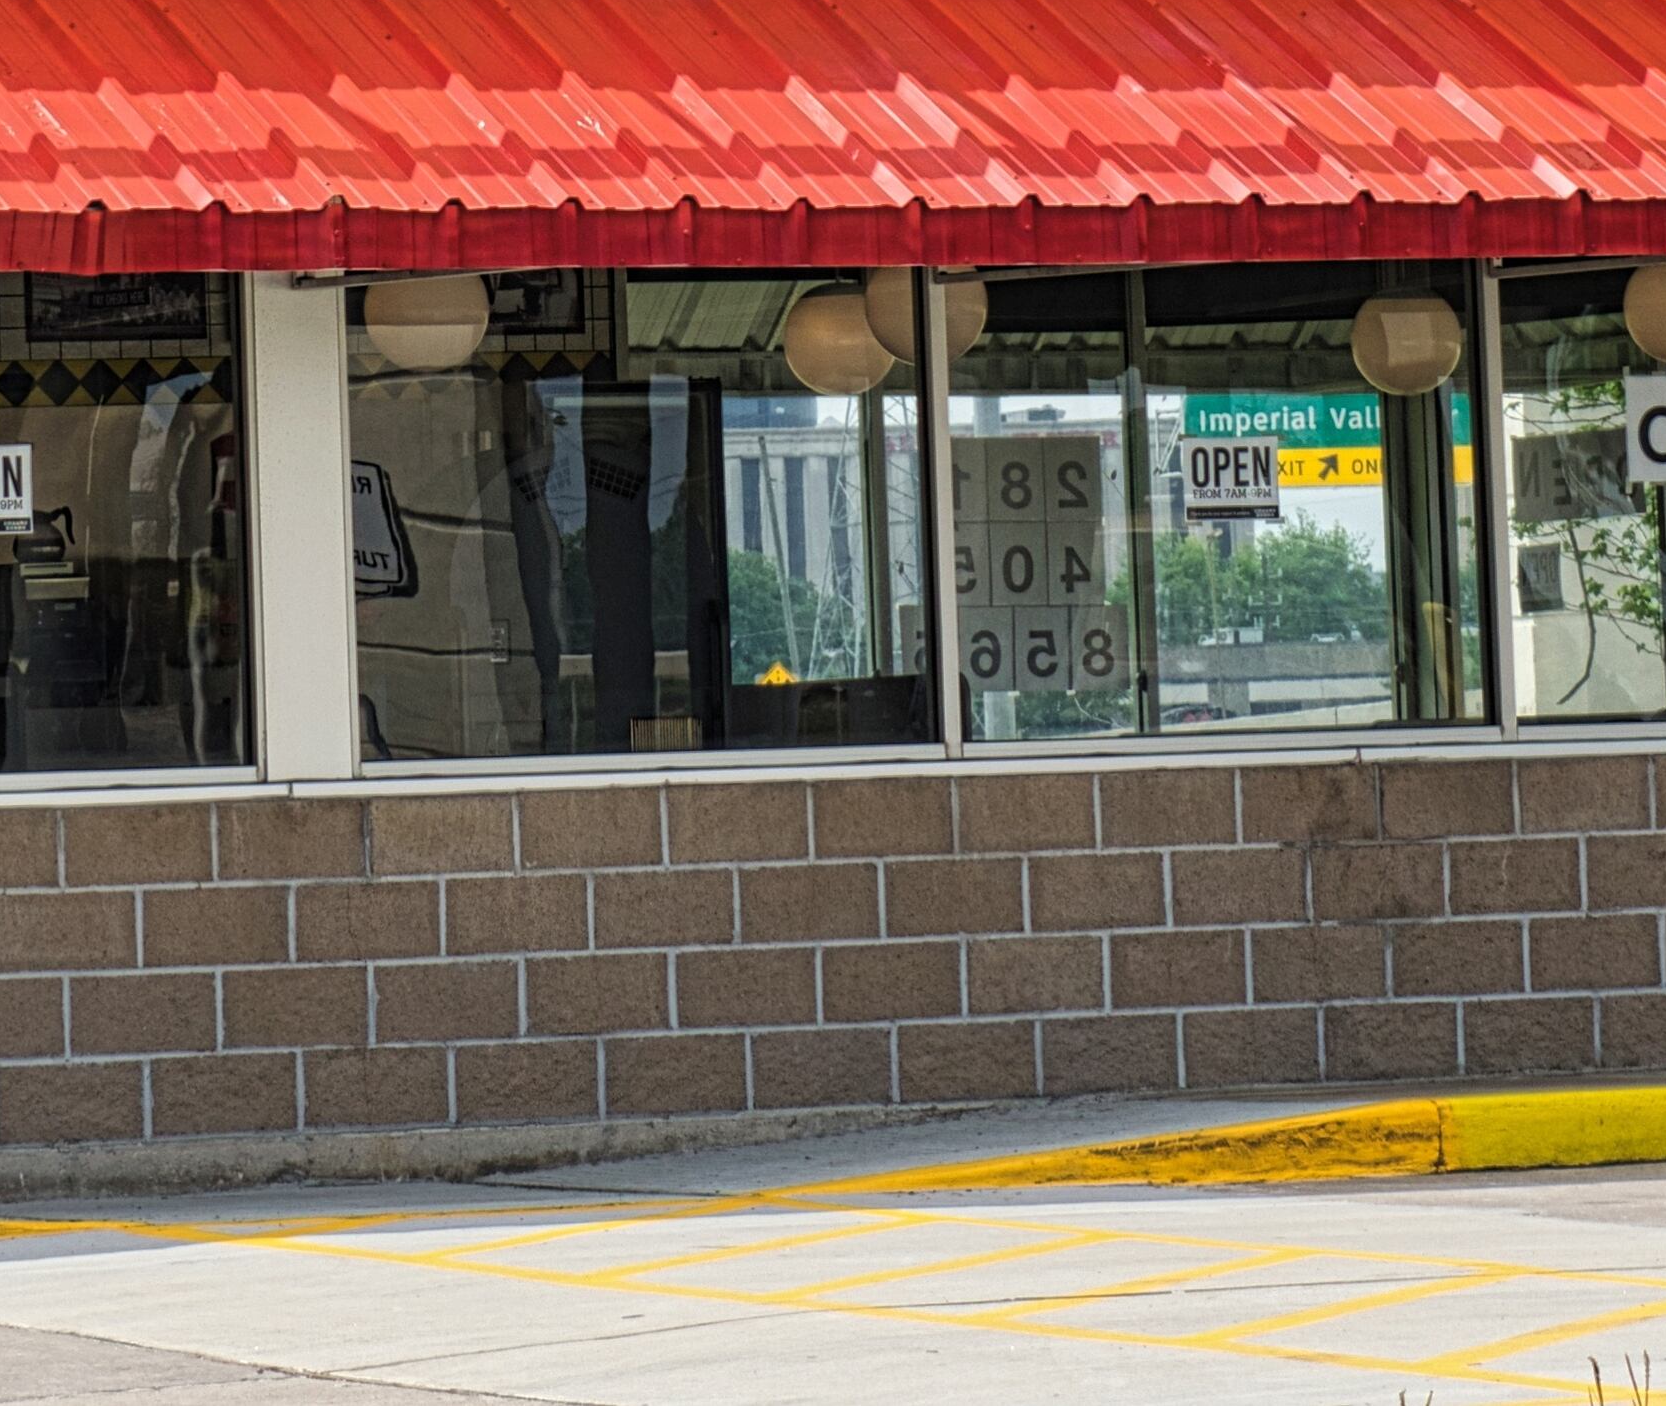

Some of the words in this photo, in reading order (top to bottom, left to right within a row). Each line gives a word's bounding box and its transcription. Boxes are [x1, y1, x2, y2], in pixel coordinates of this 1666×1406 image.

[1199, 405, 1316, 436] Imperial
[1330, 404, 1381, 430] Vall
[1191, 445, 1272, 488] OPEN
[1278, 460, 1305, 476] XIT
[1193, 488, 1222, 499] FROM
